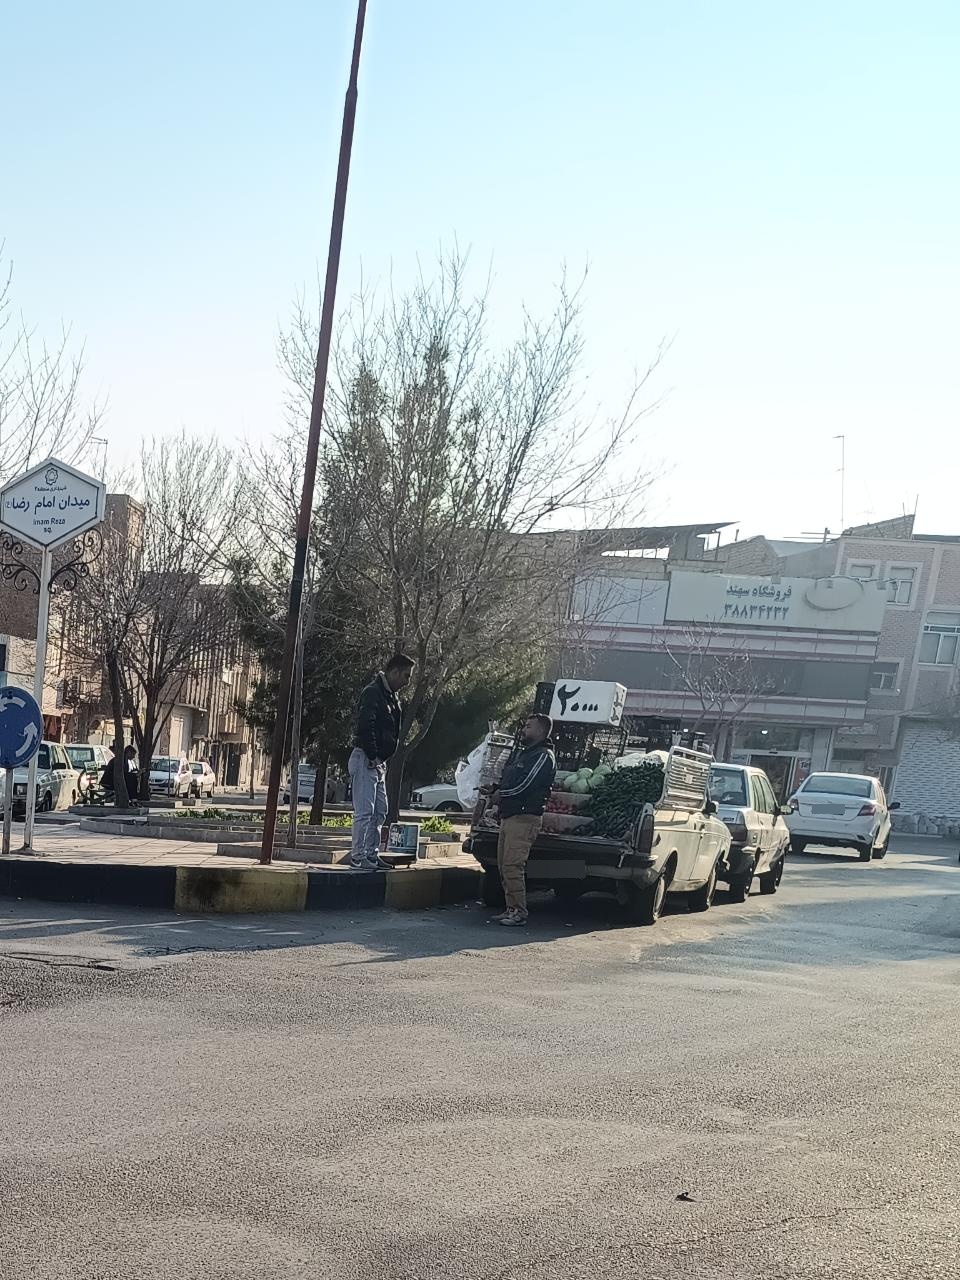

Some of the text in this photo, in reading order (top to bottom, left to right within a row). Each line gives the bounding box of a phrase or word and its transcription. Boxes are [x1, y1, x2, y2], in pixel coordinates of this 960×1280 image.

[35, 496, 56, 515] امام
[58, 495, 90, 510] میدان
[752, 585, 792, 602] فروشگاه
